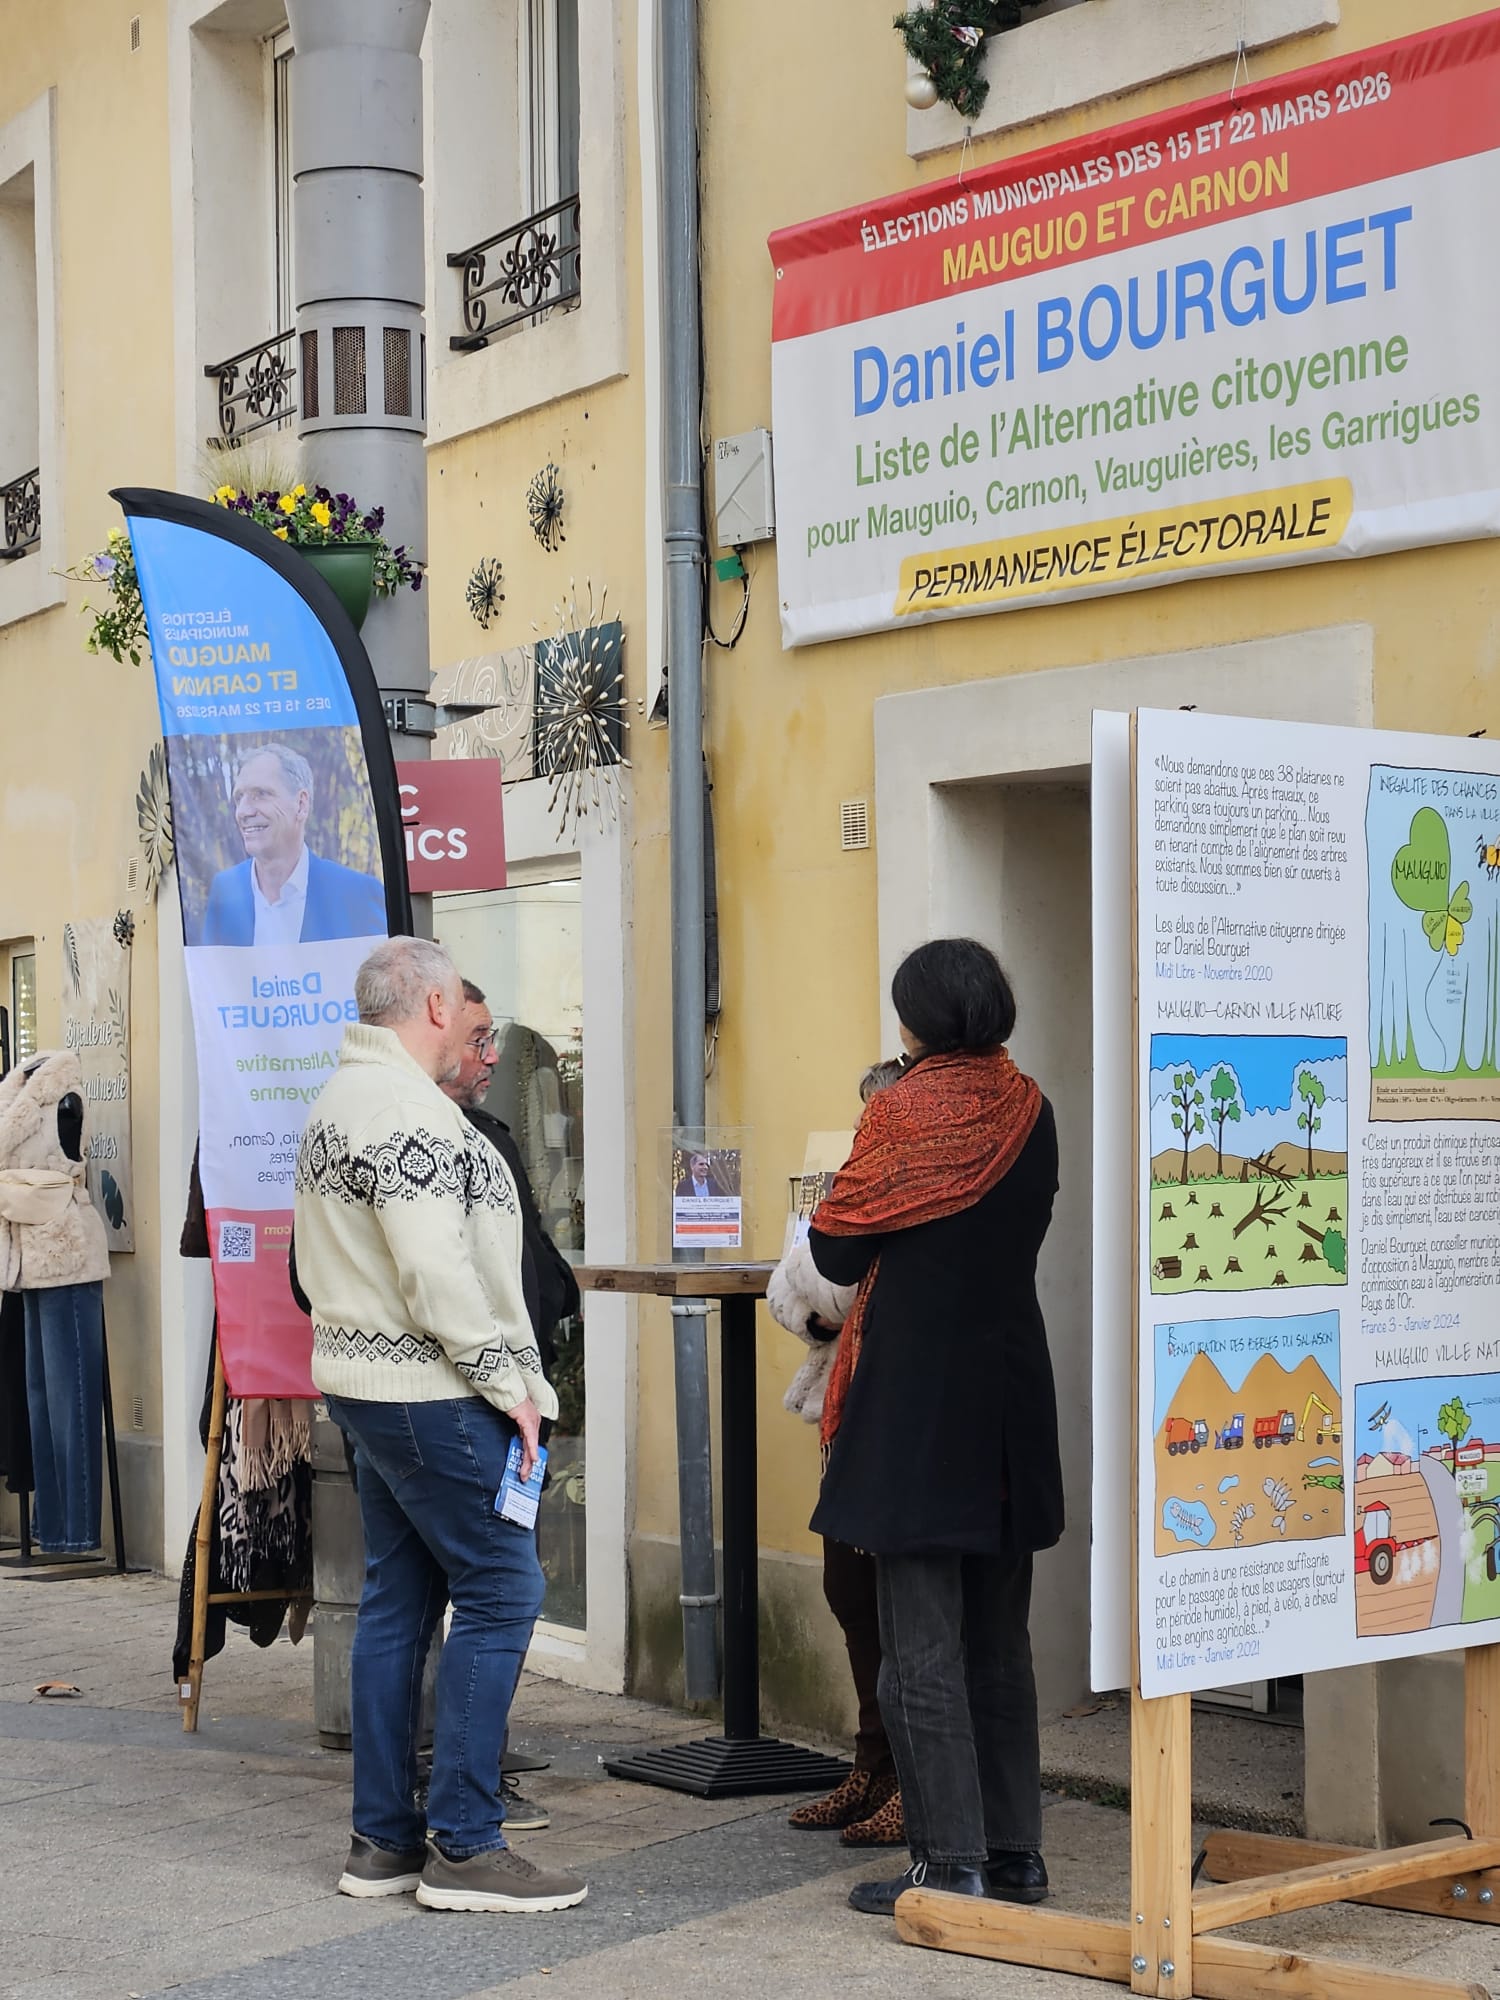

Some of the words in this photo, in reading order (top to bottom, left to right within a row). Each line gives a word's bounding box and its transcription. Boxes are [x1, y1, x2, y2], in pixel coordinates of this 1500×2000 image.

[860, 219, 968, 253] ÉLECTIONS
[973, 156, 1113, 220] MUNICIPALES
[1116, 141, 1161, 178] DES
[1167, 132, 1191, 162] 15
[1196, 121, 1224, 154] ET
[1229, 113, 1255, 144] 22
[1261, 90, 1330, 134] MARS
[1336, 72, 1391, 114] 2026
[943, 212, 1087, 285] MAUGUIO
[1097, 197, 1135, 243] ET
[1144, 152, 1288, 229] CARNON
[854, 309, 1015, 417] Daniel
[1037, 205, 1413, 374] BOURGUET
[856, 436, 929, 486] Liste
[940, 423, 979, 468] de
[991, 378, 1199, 458] l'Alternative
[1212, 335, 1409, 407] citoyenne
[807, 515, 859, 557] pour
[867, 490, 977, 538] Mauguio,
[986, 474, 1086, 514] Carnon,
[1095, 437, 1258, 494] Vauguières,
[1270, 425, 1311, 461] les
[1322, 393, 1480, 450] Garrigues
[909, 536, 1111, 601] PERMANENCE
[1117, 497, 1331, 569] ÉLECTORALE
[1187, 758, 1238, 778] demandons
[1241, 767, 1256, 783] que
[1259, 768, 1274, 781] ces
[1278, 764, 1293, 782] 38
[1296, 767, 1331, 788] platanes
[1334, 773, 1345, 786] ne
[1155, 777, 1181, 793] soient
[1185, 781, 1200, 799] pas
[1204, 779, 1238, 798] abattus.
[1272, 786, 1305, 806] travaux,
[1309, 793, 1319, 803] ce
[1453, 781, 1497, 800] CHANCES
[1155, 794, 1189, 818] parking
[1192, 802, 1211, 815] sera
[1214, 801, 1249, 822] toujours
[1252, 808, 1262, 819] un
[1309, 806, 1330, 823] Nous
[1155, 815, 1206, 834] demandons
[1209, 820, 1257, 843] simplement
[1261, 825, 1276, 844] que
[1279, 823, 1285, 840] le
[1289, 824, 1306, 845] plan
[1310, 828, 1324, 842] soit
[1328, 831, 1345, 843] revu
[1155, 840, 1166, 850] en
[1170, 839, 1198, 854] tenant
[1201, 842, 1233, 861] compte
[1236, 840, 1246, 857] de
[1250, 840, 1300, 863] l'alignement
[1303, 844, 1318, 861] des
[1321, 846, 1347, 863] arbres
[1156, 857, 1197, 874] existants.
[1200, 857, 1222, 875] Nous
[1226, 863, 1261, 877] sommes
[1264, 863, 1282, 878] bien
[1301, 867, 1332, 881] ouverts
[1335, 867, 1341, 882] à
[1156, 876, 1178, 892] toute
[1156, 914, 1172, 933] Les
[1176, 916, 1194, 935] élus
[1198, 916, 1208, 935] de
[1212, 916, 1266, 937] l'Alternative
[1270, 922, 1313, 943] citoyenne
[1316, 921, 1345, 945] dirigée
[1156, 940, 1171, 960] par
[1175, 936, 1204, 956] Daniel
[1208, 937, 1250, 962] Bourguet
[1156, 962, 1174, 978] Midi
[1176, 963, 1195, 979] Libre
[1204, 964, 1242, 980] Novembre
[1245, 965, 1273, 981] 2020
[1266, 1001, 1296, 1021] VILLE
[1301, 1001, 1343, 1022] NATURE
[1361, 1294, 1382, 1316] Pays
[1385, 1294, 1395, 1309] de
[1362, 1320, 1386, 1334] France
[1389, 1317, 1396, 1332] 3
[1404, 1317, 1431, 1331] Janvier
[1434, 1314, 1460, 1328] 2024
[1230, 1339, 1244, 1352] DES
[1296, 1332, 1333, 1346] SALAISON
[1376, 1346, 1428, 1368] MAUGUIO
[1436, 1341, 1470, 1361] VILLE
[1179, 1568, 1210, 1586] chemin
[1213, 1570, 1218, 1581] à
[1221, 1568, 1237, 1580] une
[1240, 1560, 1284, 1576] résistance
[1287, 1552, 1329, 1571] suffisante
[1156, 1593, 1175, 1615] pour
[1179, 1588, 1185, 1605] le
[1189, 1588, 1225, 1610] passage
[1228, 1582, 1238, 1598] de
[1241, 1583, 1260, 1596] tous
[1263, 1577, 1274, 1594] les
[1277, 1578, 1310, 1597] usagers
[1313, 1569, 1345, 1589] (surtout
[1156, 1618, 1166, 1629] en
[1170, 1612, 1201, 1631] période
[1244, 1605, 1249, 1616] à
[1252, 1602, 1271, 1620] pied,
[1275, 1599, 1280, 1611] à
[1283, 1597, 1301, 1610] vélo,
[1305, 1596, 1309, 1607] à
[1313, 1586, 1338, 1605] cheval
[1156, 1637, 1167, 1649] ou
[1170, 1629, 1181, 1647] les
[1185, 1629, 1214, 1648] engins
[1157, 1654, 1174, 1670] Midi
[1177, 1651, 1195, 1668] Libre
[1205, 1647, 1234, 1664] Janvier
[1237, 1640, 1259, 1658] 2021
